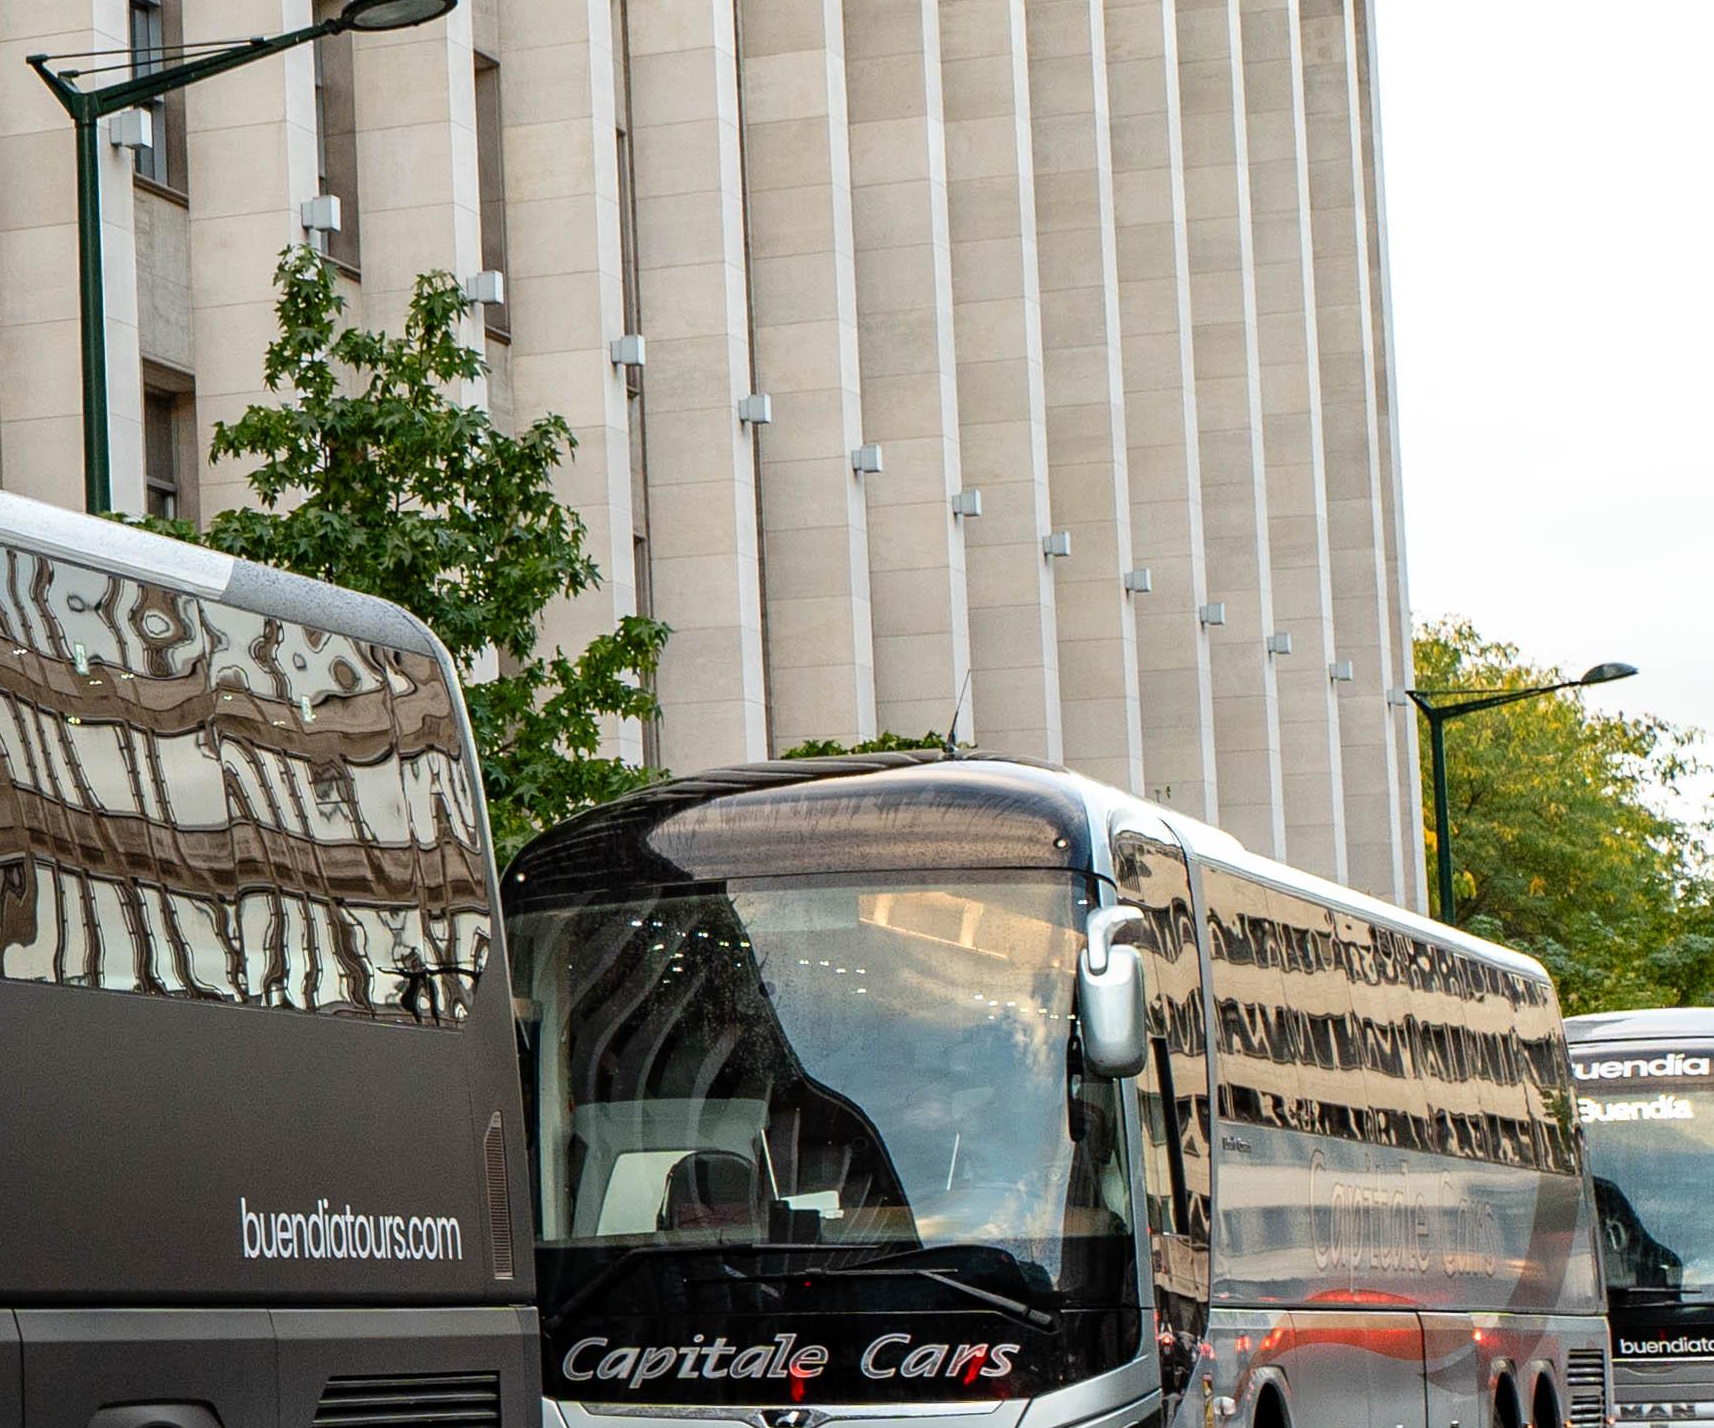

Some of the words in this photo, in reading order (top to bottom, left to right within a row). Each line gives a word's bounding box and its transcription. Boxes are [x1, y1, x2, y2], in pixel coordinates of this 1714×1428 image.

[1572, 1053, 1710, 1080] uendía
[240, 1197, 462, 1259] buendiatours.com
[562, 1333, 829, 1388] Capitale
[861, 1333, 1020, 1378] Cars
